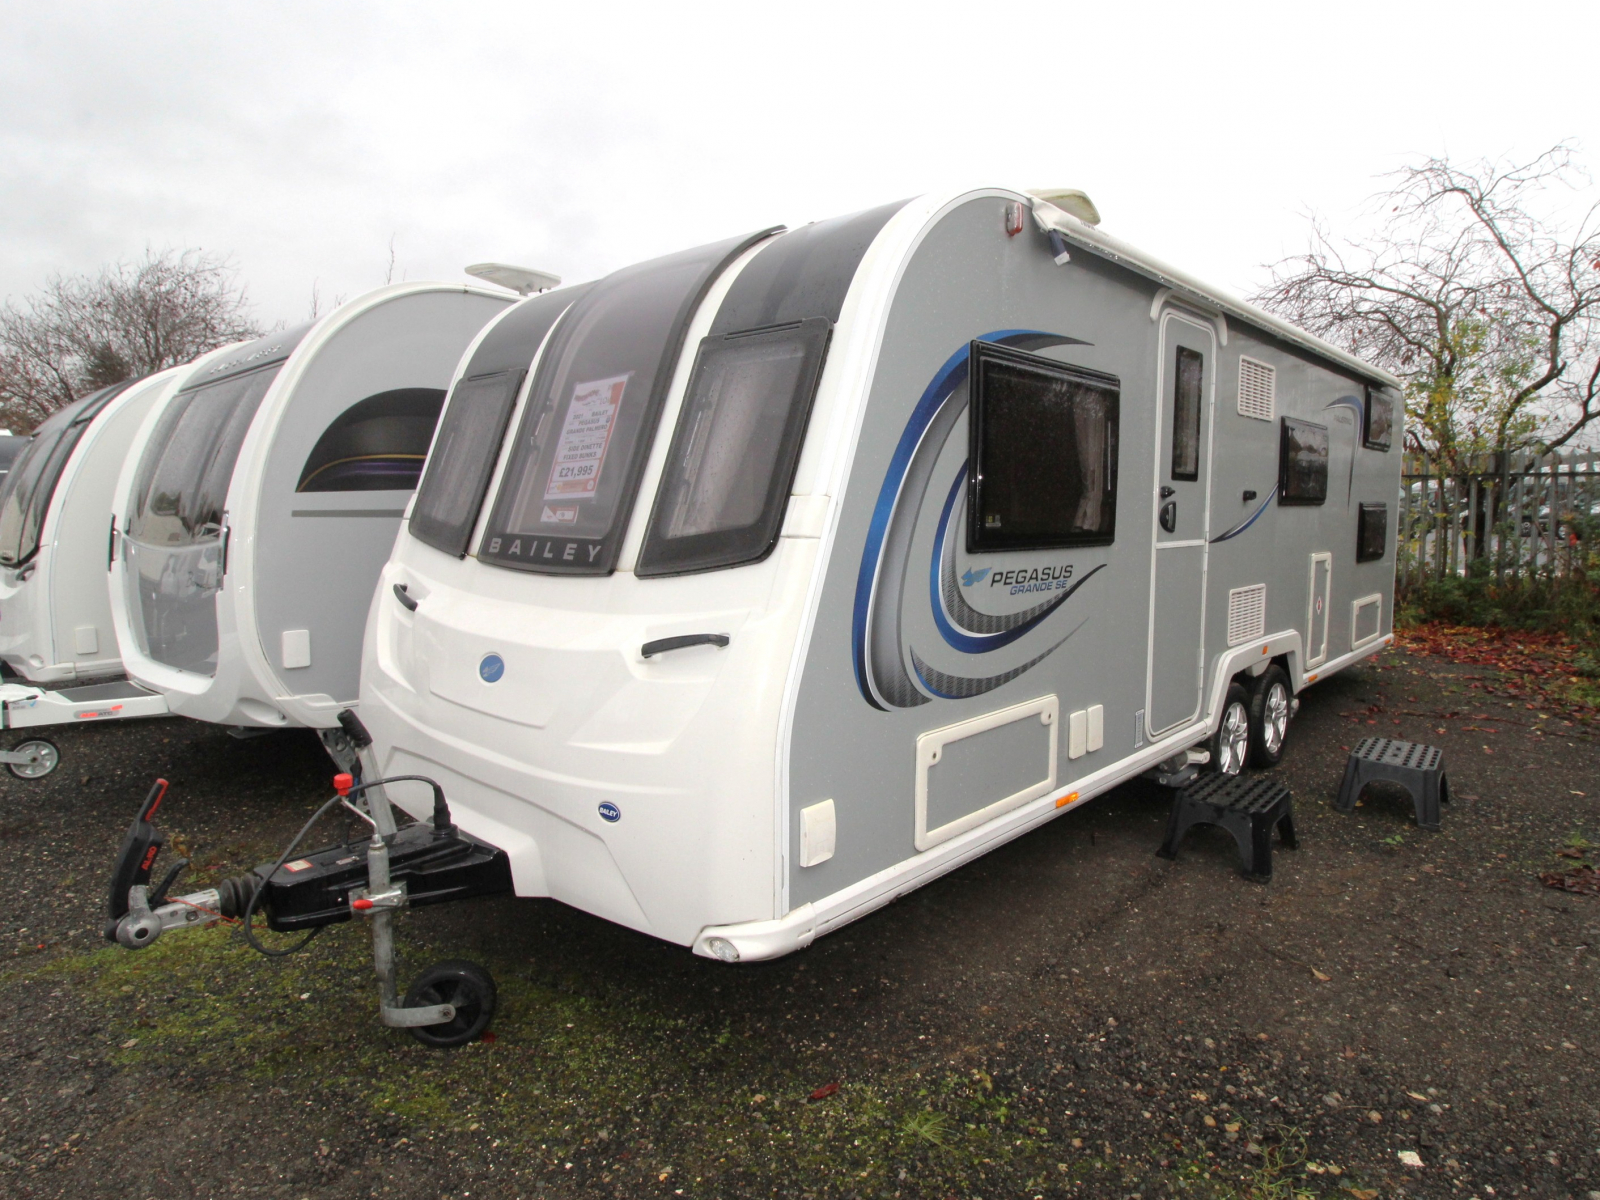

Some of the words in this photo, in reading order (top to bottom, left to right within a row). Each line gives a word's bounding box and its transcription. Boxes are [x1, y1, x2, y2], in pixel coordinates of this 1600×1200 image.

[591, 409, 609, 417] BAILEY
[578, 418, 600, 426] PEGASUS
[566, 427, 586, 435] GRANDE
[580, 442, 603, 451] DINETTE
[579, 451, 597, 459] BUNKS
[559, 465, 594, 478] £21,995
[489, 537, 602, 562] BAILEY
[991, 565, 1074, 587] PEGASUS
[1010, 581, 1053, 595] GRANDE
[1055, 579, 1068, 589] SE
[599, 807, 618, 817] BAILEY
